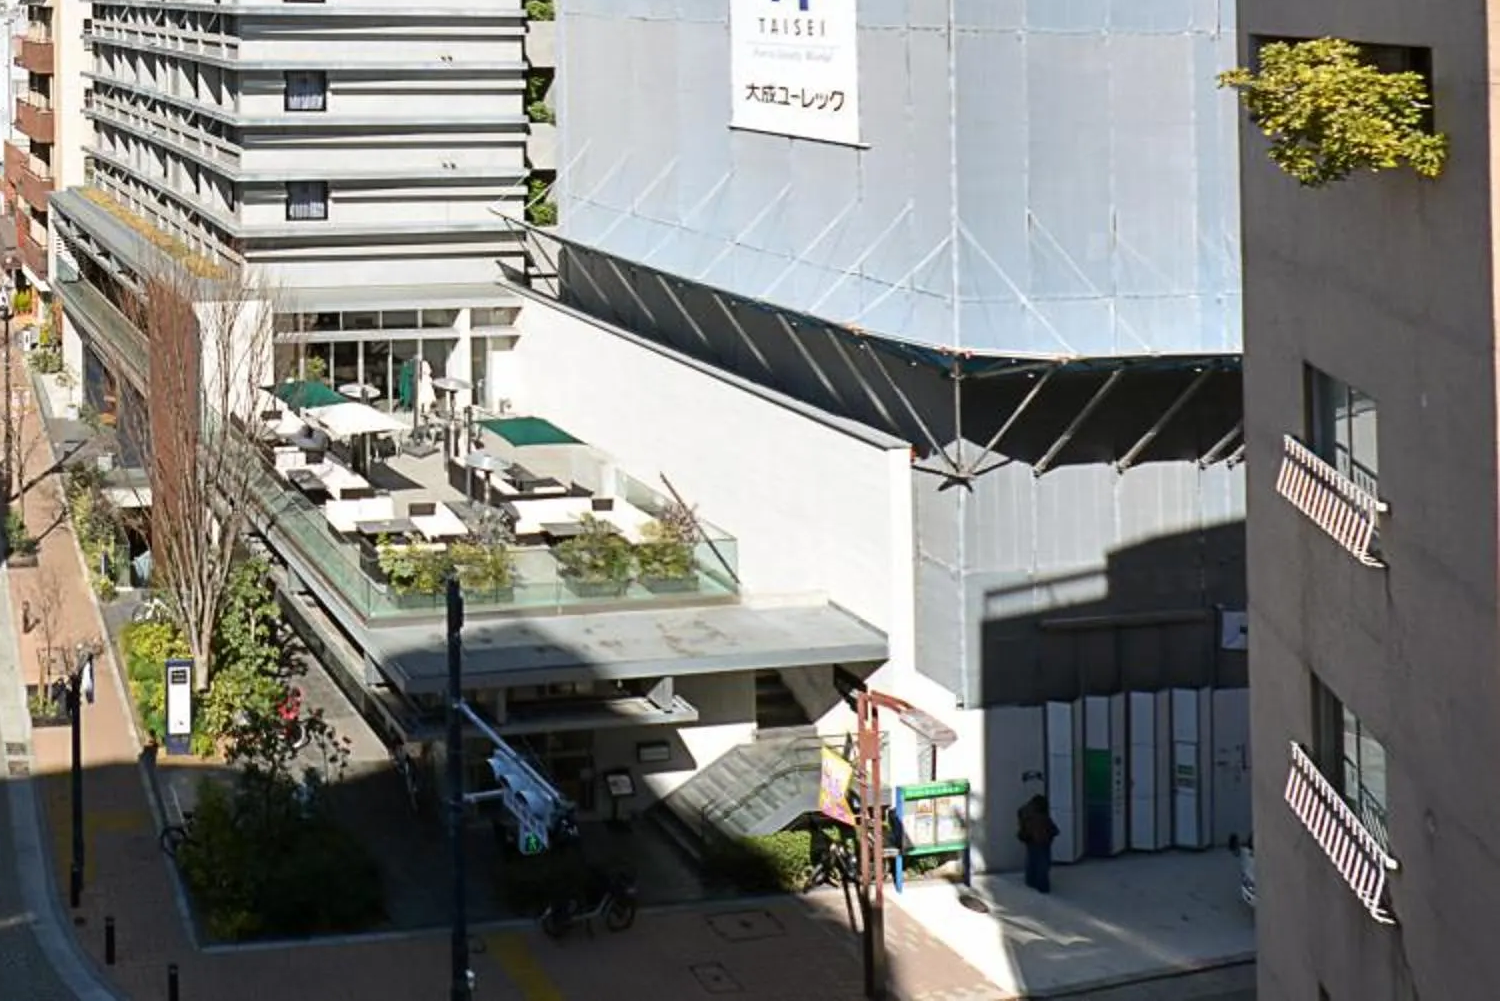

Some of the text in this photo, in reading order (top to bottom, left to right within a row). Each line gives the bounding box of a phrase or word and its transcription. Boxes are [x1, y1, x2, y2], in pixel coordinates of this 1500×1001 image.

[758, 17, 826, 36] TAISEI
[745, 83, 845, 112] 大成ユーレック
